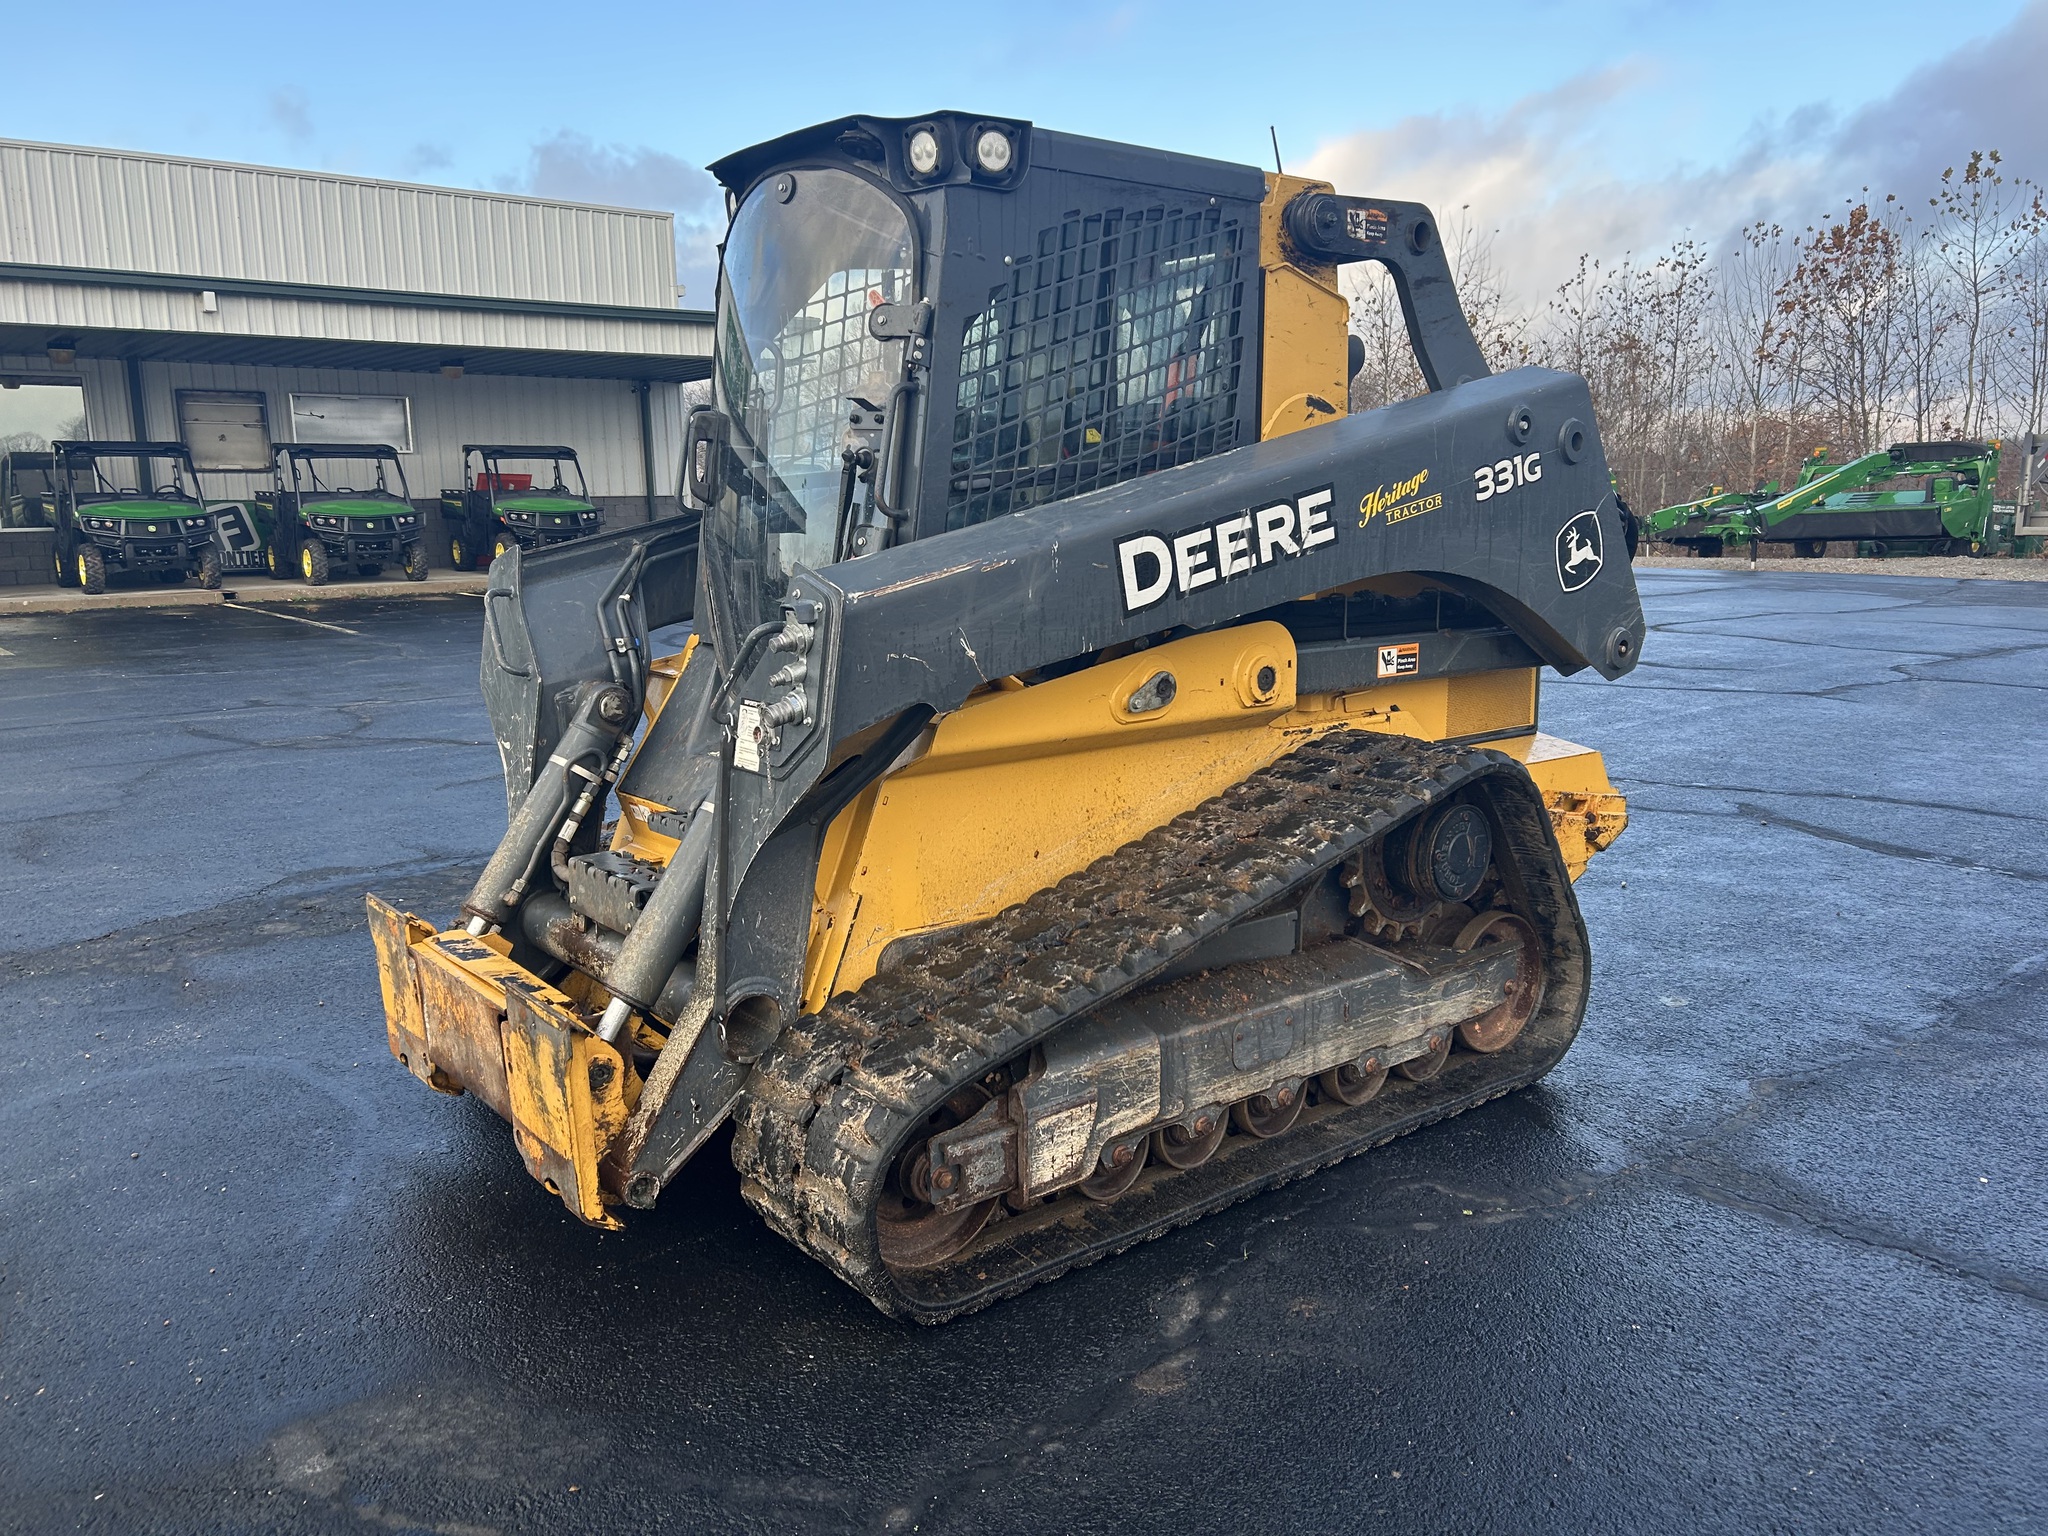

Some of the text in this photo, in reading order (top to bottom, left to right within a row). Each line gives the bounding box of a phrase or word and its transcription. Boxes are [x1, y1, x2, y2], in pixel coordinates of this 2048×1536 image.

[1358, 468, 1429, 528] Heritage
[1474, 452, 1543, 501] 331G
[1385, 495, 1442, 522] TRACTOR
[219, 550, 267, 567] ONTIER
[1118, 488, 1336, 611] DEERE
